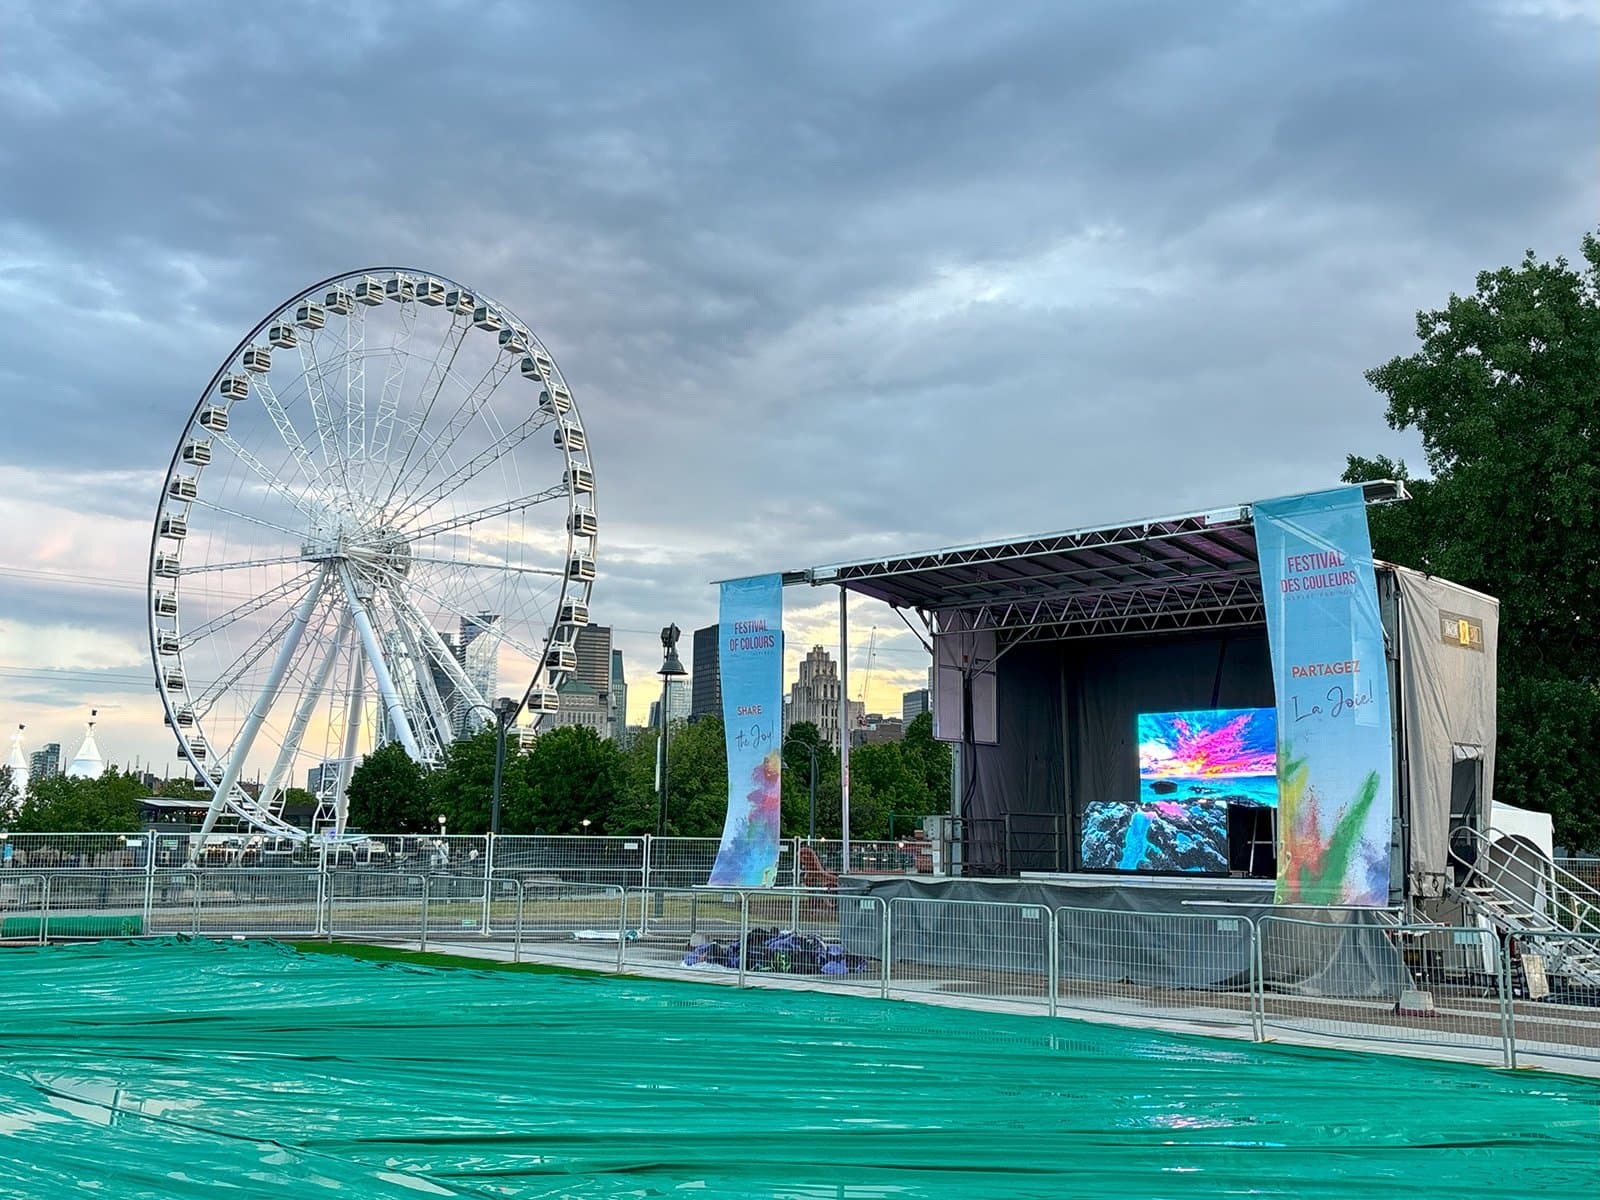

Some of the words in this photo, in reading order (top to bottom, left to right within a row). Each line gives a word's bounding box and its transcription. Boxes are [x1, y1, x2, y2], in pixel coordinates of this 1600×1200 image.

[1287, 550, 1345, 573] FESTIVAL
[1281, 575, 1300, 592] DES
[1303, 570, 1357, 590] COULEURS
[735, 620, 768, 634] FESTIVAL
[730, 639, 739, 651] OF
[741, 635, 775, 650] COLOURS
[1292, 660, 1360, 678] PARTAGEZ
[737, 705, 762, 716] SHARE
[1292, 695, 1323, 722] La
[1327, 679, 1374, 718] Joie!
[736, 729, 749, 751] the
[751, 720, 775, 748] Joy!
